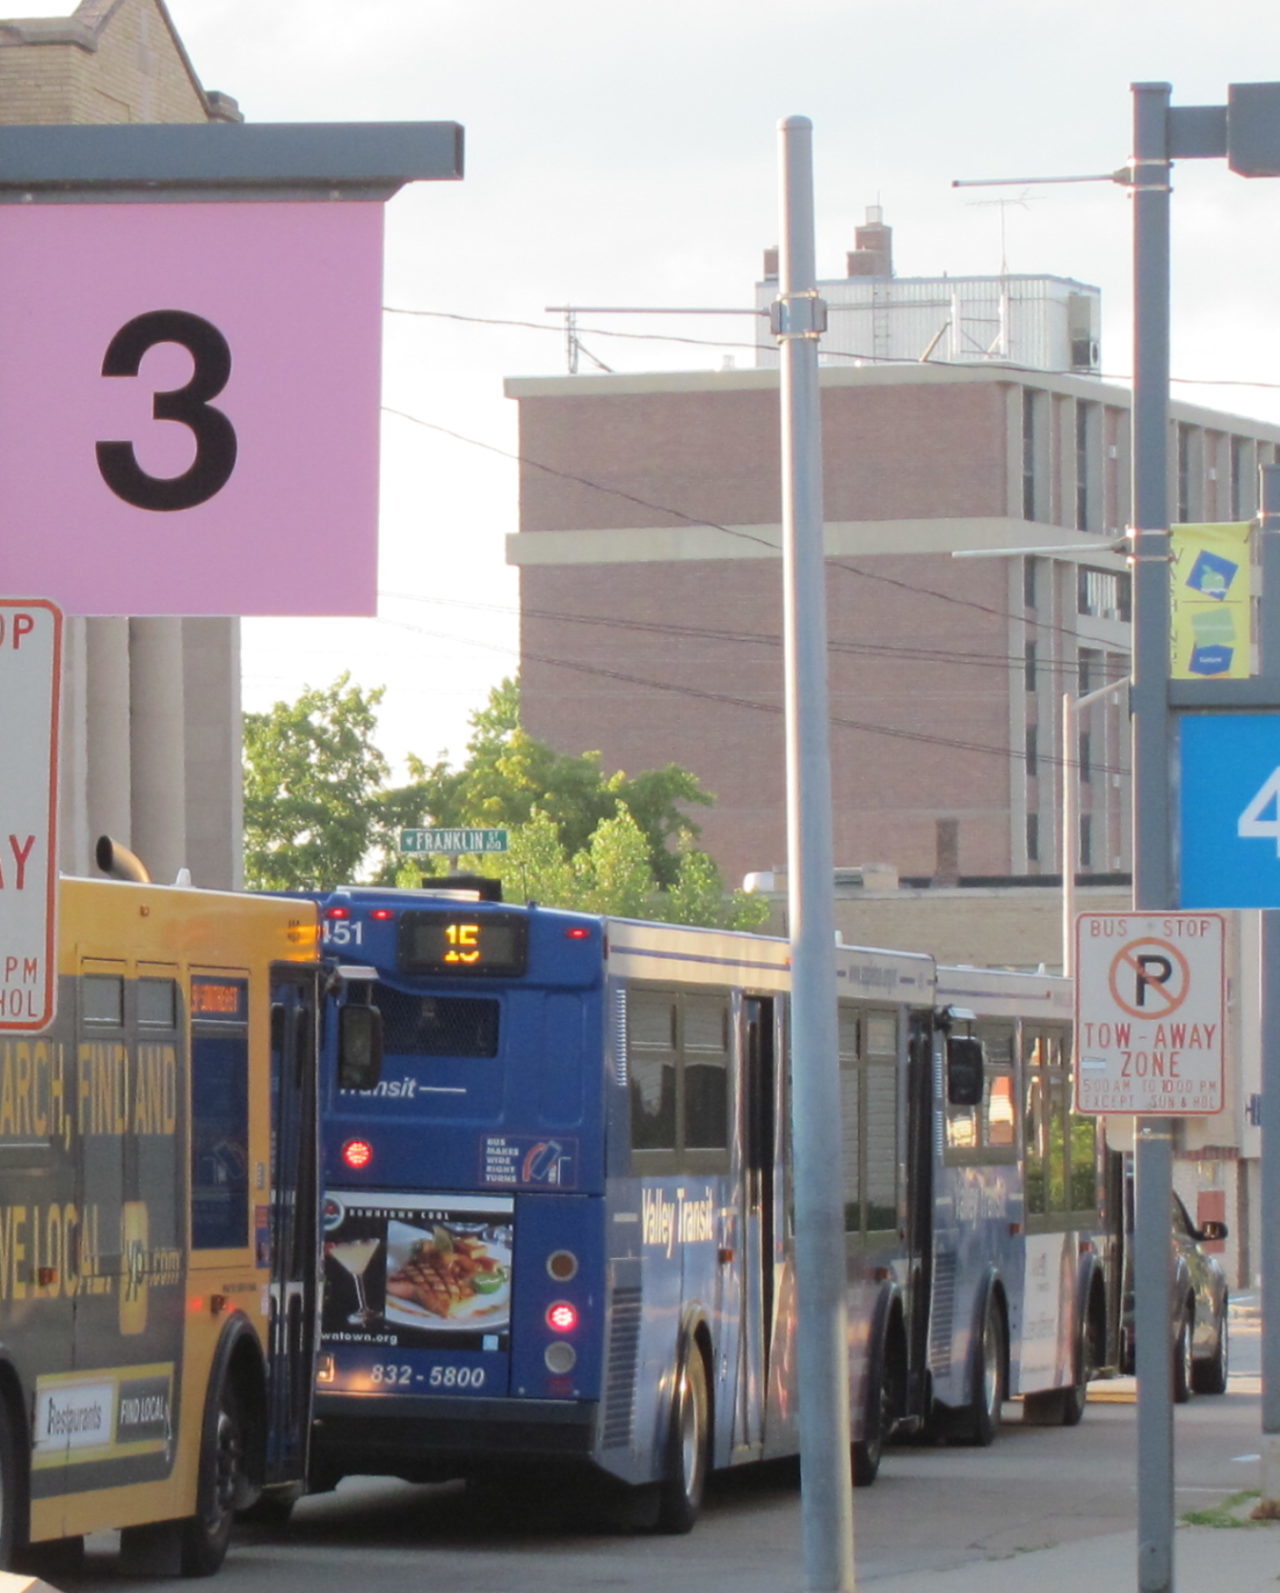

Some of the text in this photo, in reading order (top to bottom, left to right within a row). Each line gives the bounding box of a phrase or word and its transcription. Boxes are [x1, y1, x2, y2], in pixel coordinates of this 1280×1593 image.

[95, 309, 238, 512] 3
[1237, 766, 1280, 858] 4
[415, 831, 483, 850] FRANKLIN
[1090, 919, 1210, 937] BUS STOP
[5, 955, 39, 985] PM
[1136, 954, 1173, 1006] P
[1120, 1051, 1181, 1078] ZONE
[77, 1042, 129, 1136] FIND
[134, 1043, 177, 1137] AND
[339, 1076, 417, 1098] nsit
[1199, 1080, 1218, 1093] PM
[1084, 1094, 1135, 1108] EXCEPT
[1150, 1094, 1176, 1108] SUN
[486, 1147, 519, 1156] MAKES
[487, 1138, 506, 1146] BUS
[486, 1156, 511, 1165] WIDE
[486, 1165, 515, 1173] RIGHT
[485, 1174, 517, 1183] TURNS
[349, 1208, 414, 1219] DOWNTOWN
[642, 1186, 713, 1259] Valley Transit
[47, 1396, 102, 1435] Restaurants
[121, 1393, 164, 1426] FIND LOCAL
